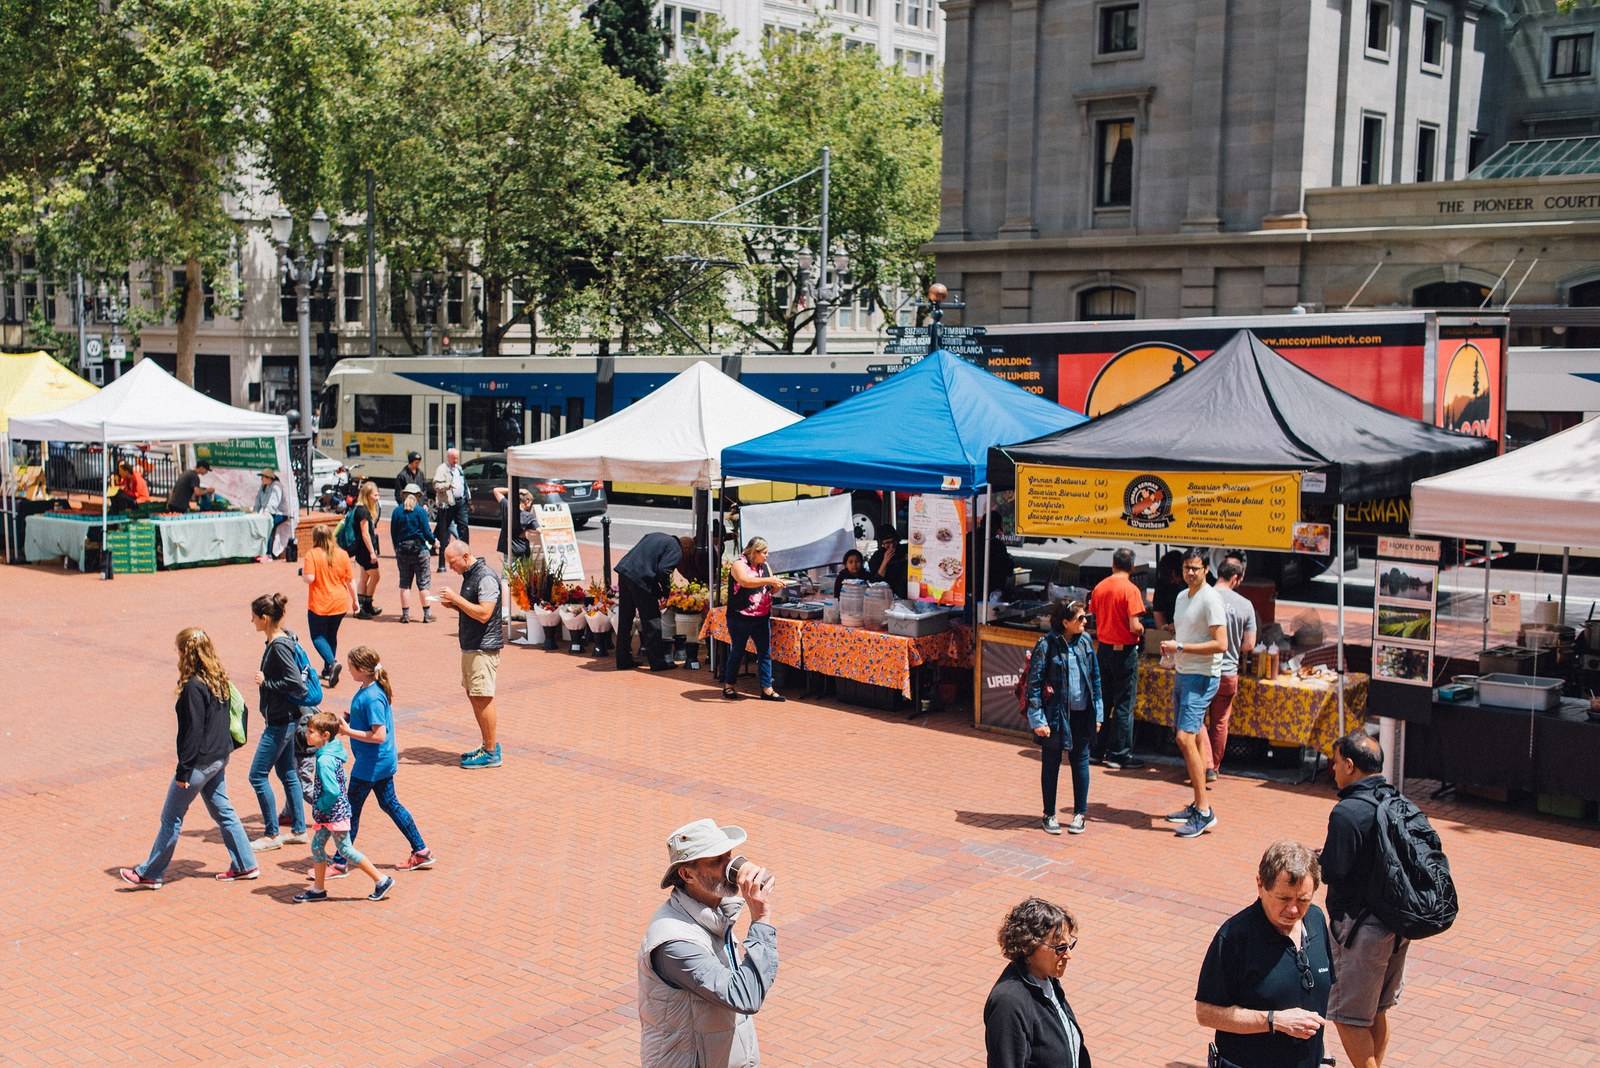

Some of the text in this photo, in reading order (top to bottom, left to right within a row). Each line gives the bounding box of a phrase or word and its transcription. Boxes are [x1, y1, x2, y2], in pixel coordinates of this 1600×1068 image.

[1437, 200, 1465, 213] THE
[1473, 198, 1534, 212] PIONEER
[944, 327, 974, 335] TIMBUKTU
[944, 346, 983, 354] CASABLANCA
[988, 357, 1032, 366] MOULDING
[1007, 372, 1040, 380] LUMBER
[321, 439, 336, 447] MAX
[1028, 476, 1053, 485] German
[1054, 477, 1087, 485] Bratwurst
[1187, 482, 1220, 491] Bavarian
[1028, 488, 1057, 496] Bavarian
[1187, 496, 1215, 505] German
[1216, 496, 1240, 504] Potato
[1242, 497, 1264, 505] Salad
[1028, 512, 1054, 522] Sausage
[1187, 508, 1208, 516] Wurst
[1219, 510, 1243, 518] Kraut
[1389, 542, 1437, 552] HONEY BOWL
[986, 674, 1021, 688] URBA
